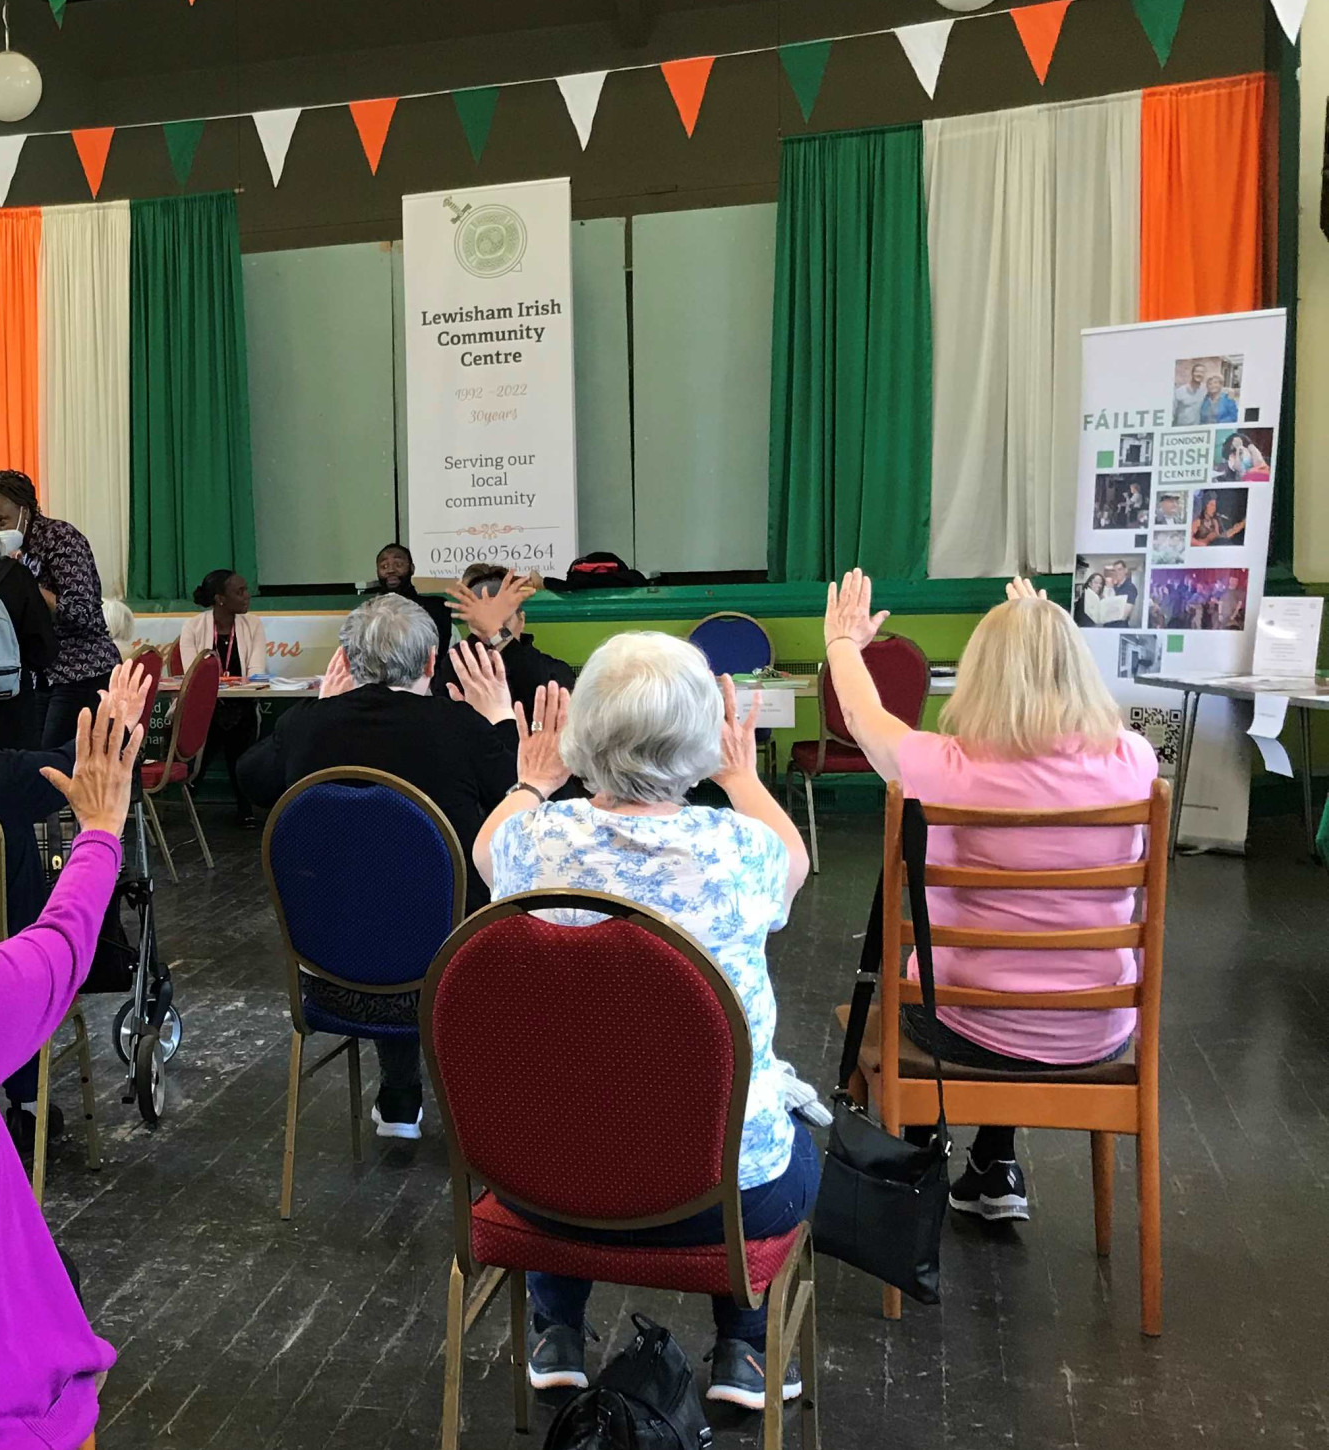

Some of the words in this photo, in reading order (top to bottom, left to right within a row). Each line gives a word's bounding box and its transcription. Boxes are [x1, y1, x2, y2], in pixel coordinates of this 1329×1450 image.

[421, 305, 513, 326] Lewisham
[517, 299, 562, 318] Irish
[437, 325, 546, 347] Community
[460, 350, 523, 367] Centre
[454, 387, 483, 402] 1992
[496, 384, 528, 398] 2022
[1083, 408, 1165, 431] FÁILTE
[1166, 436, 1205, 446] LONDON
[444, 454, 504, 470] Serving
[507, 453, 536, 466] our
[1159, 448, 1210, 467] IRISH
[471, 472, 508, 488] local
[1164, 469, 1202, 479] CENTRE
[445, 491, 536, 508] community
[430, 543, 554, 564] 02086956264
[265, 641, 303, 658] ars
